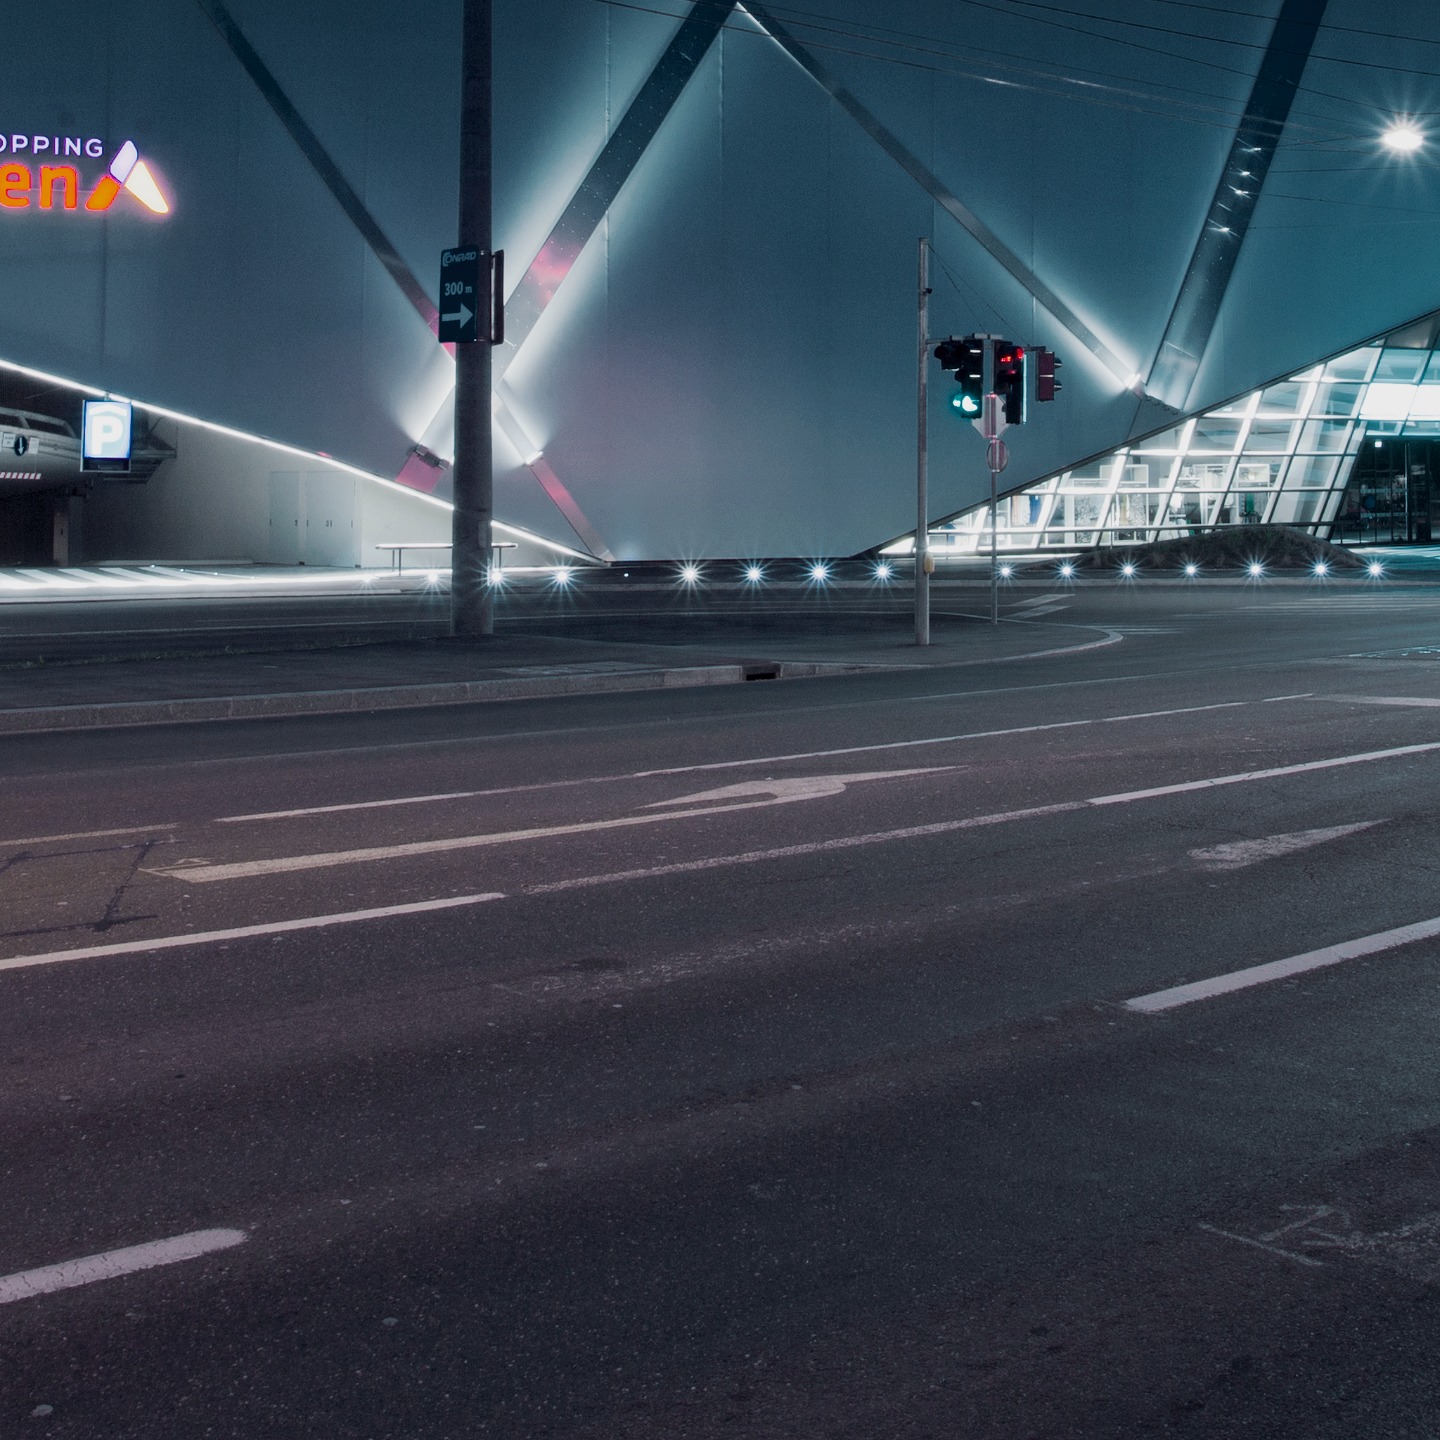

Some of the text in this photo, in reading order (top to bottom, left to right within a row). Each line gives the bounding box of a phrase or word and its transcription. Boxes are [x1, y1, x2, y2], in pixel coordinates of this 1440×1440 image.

[442, 251, 477, 267] CONRAD
[444, 281, 473, 296] 300 m
[92, 415, 123, 456] P
